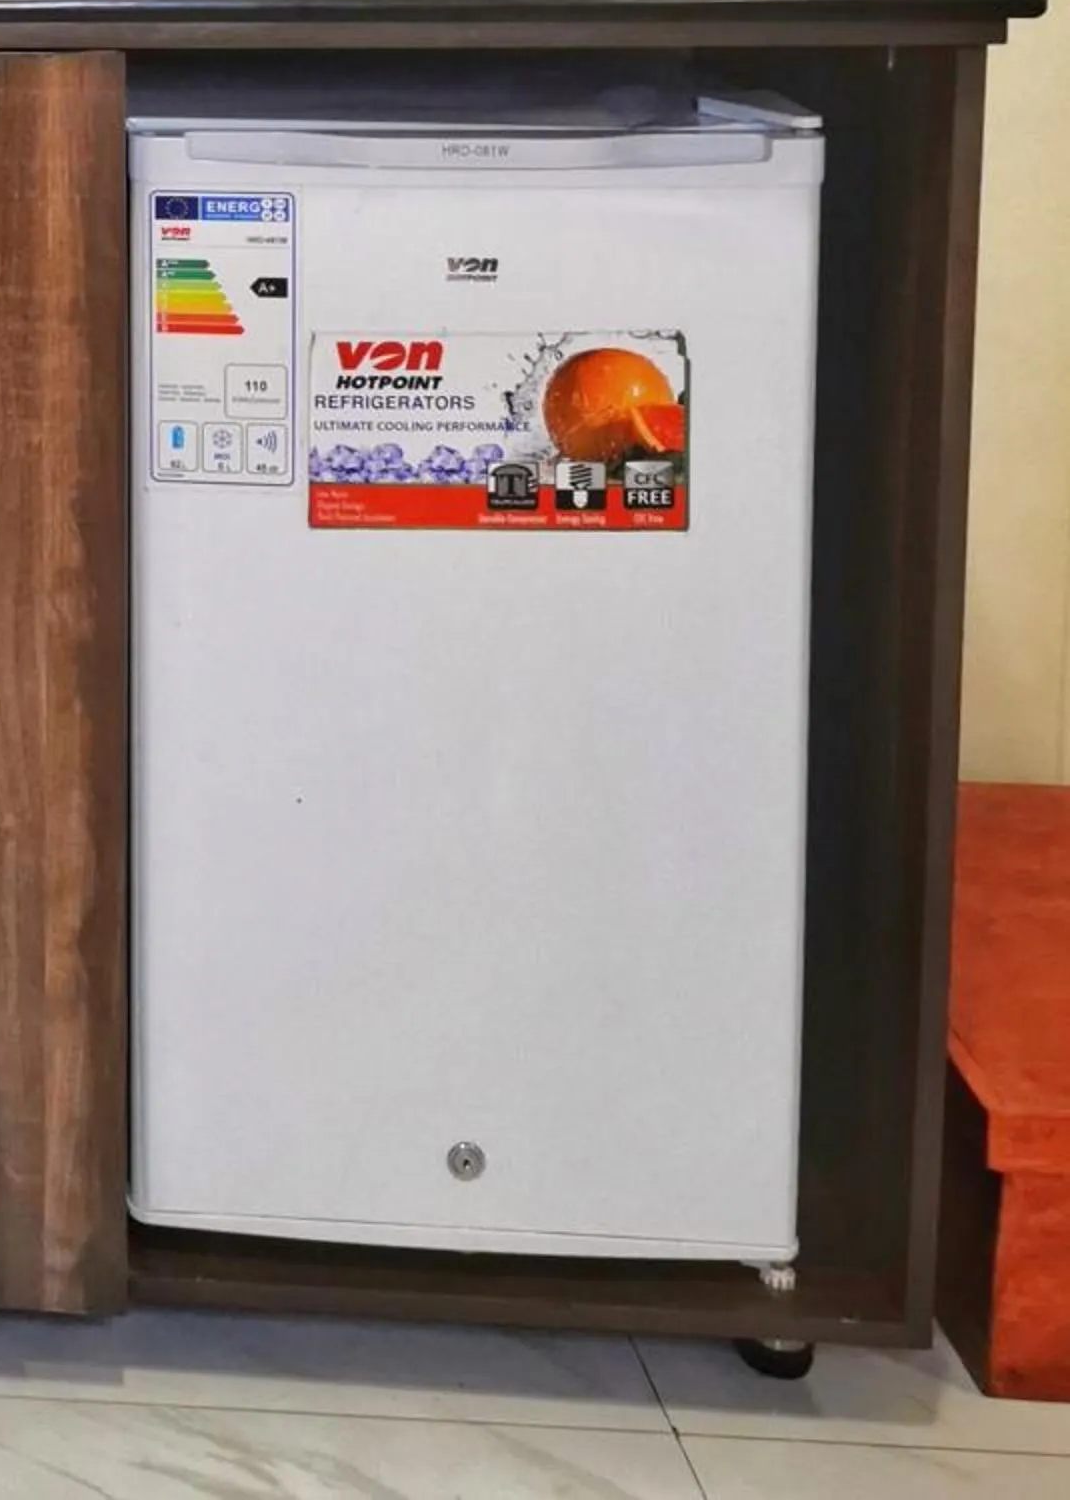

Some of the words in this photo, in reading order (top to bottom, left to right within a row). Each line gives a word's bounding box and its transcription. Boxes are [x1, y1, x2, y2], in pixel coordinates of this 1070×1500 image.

[205, 200, 261, 213] ENERG
[257, 281, 277, 293] A+
[244, 379, 268, 392] 110
[335, 375, 444, 390] HOTPOINT
[314, 394, 476, 411] REFRIGERATORS
[313, 420, 373, 432] ULTIMATE
[376, 420, 434, 432] COOLING
[436, 420, 531, 433] PERFORMANCE
[633, 472, 664, 485] CFC
[627, 490, 672, 506] FREE
